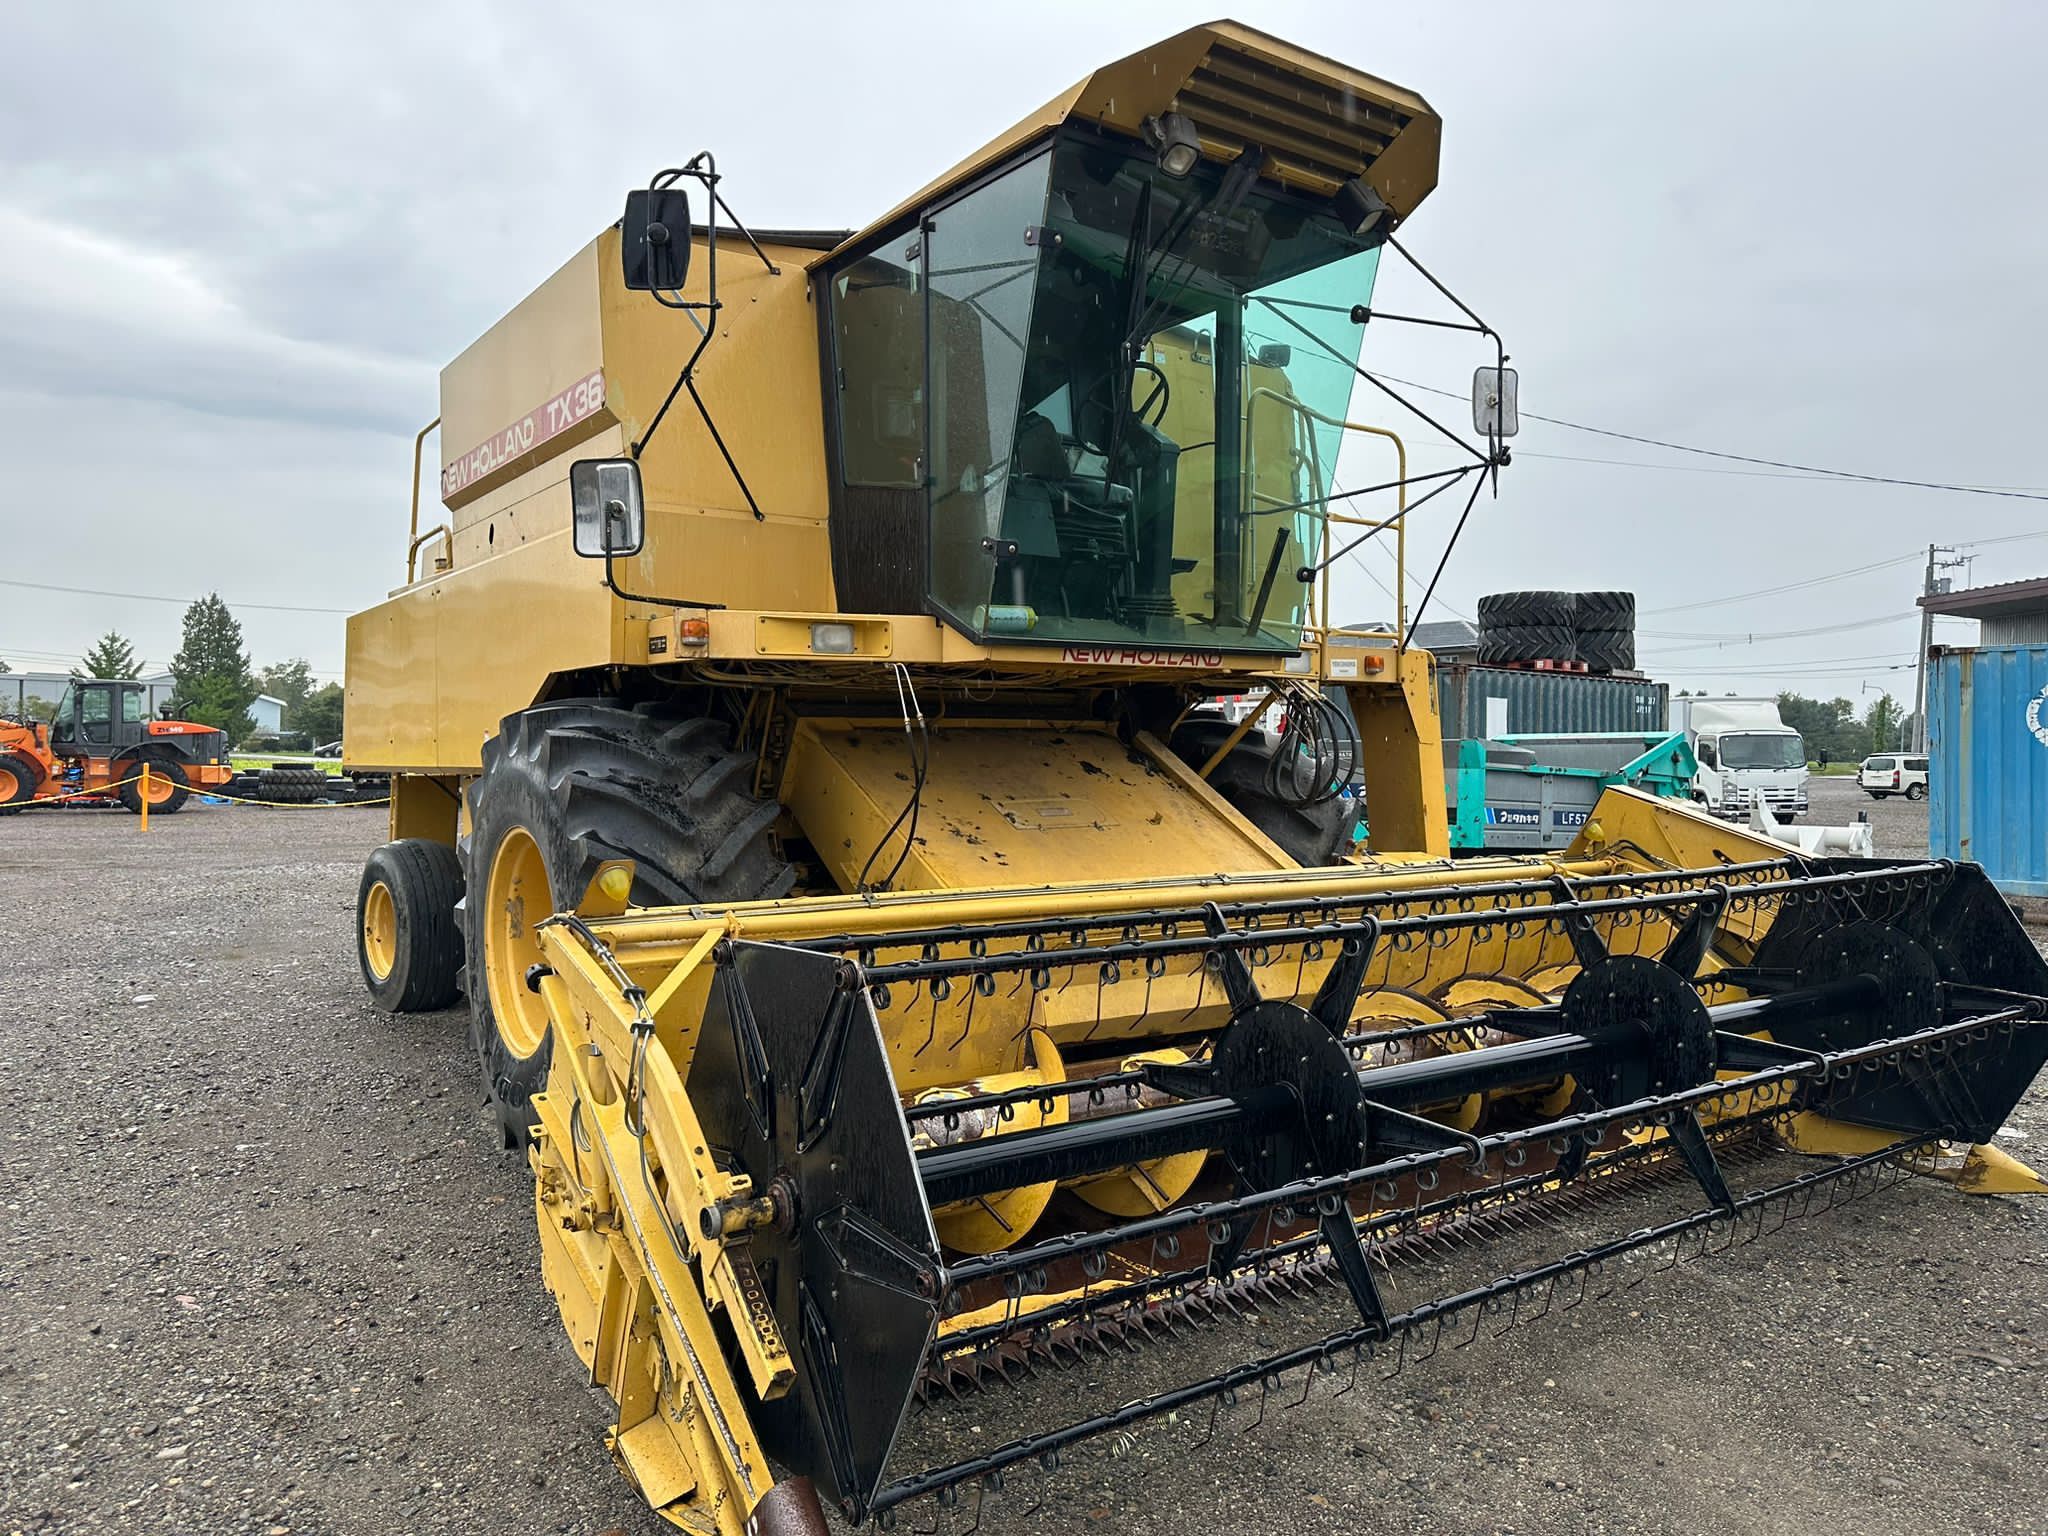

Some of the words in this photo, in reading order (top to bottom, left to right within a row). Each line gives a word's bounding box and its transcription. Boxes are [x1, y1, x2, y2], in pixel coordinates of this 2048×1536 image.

[442, 455, 471, 497] NEW
[470, 417, 535, 480] HOLLAND
[547, 391, 573, 433] TX
[575, 374, 602, 417] 36
[1062, 648, 1114, 662] NEW
[1119, 651, 1223, 667] HOLLAND
